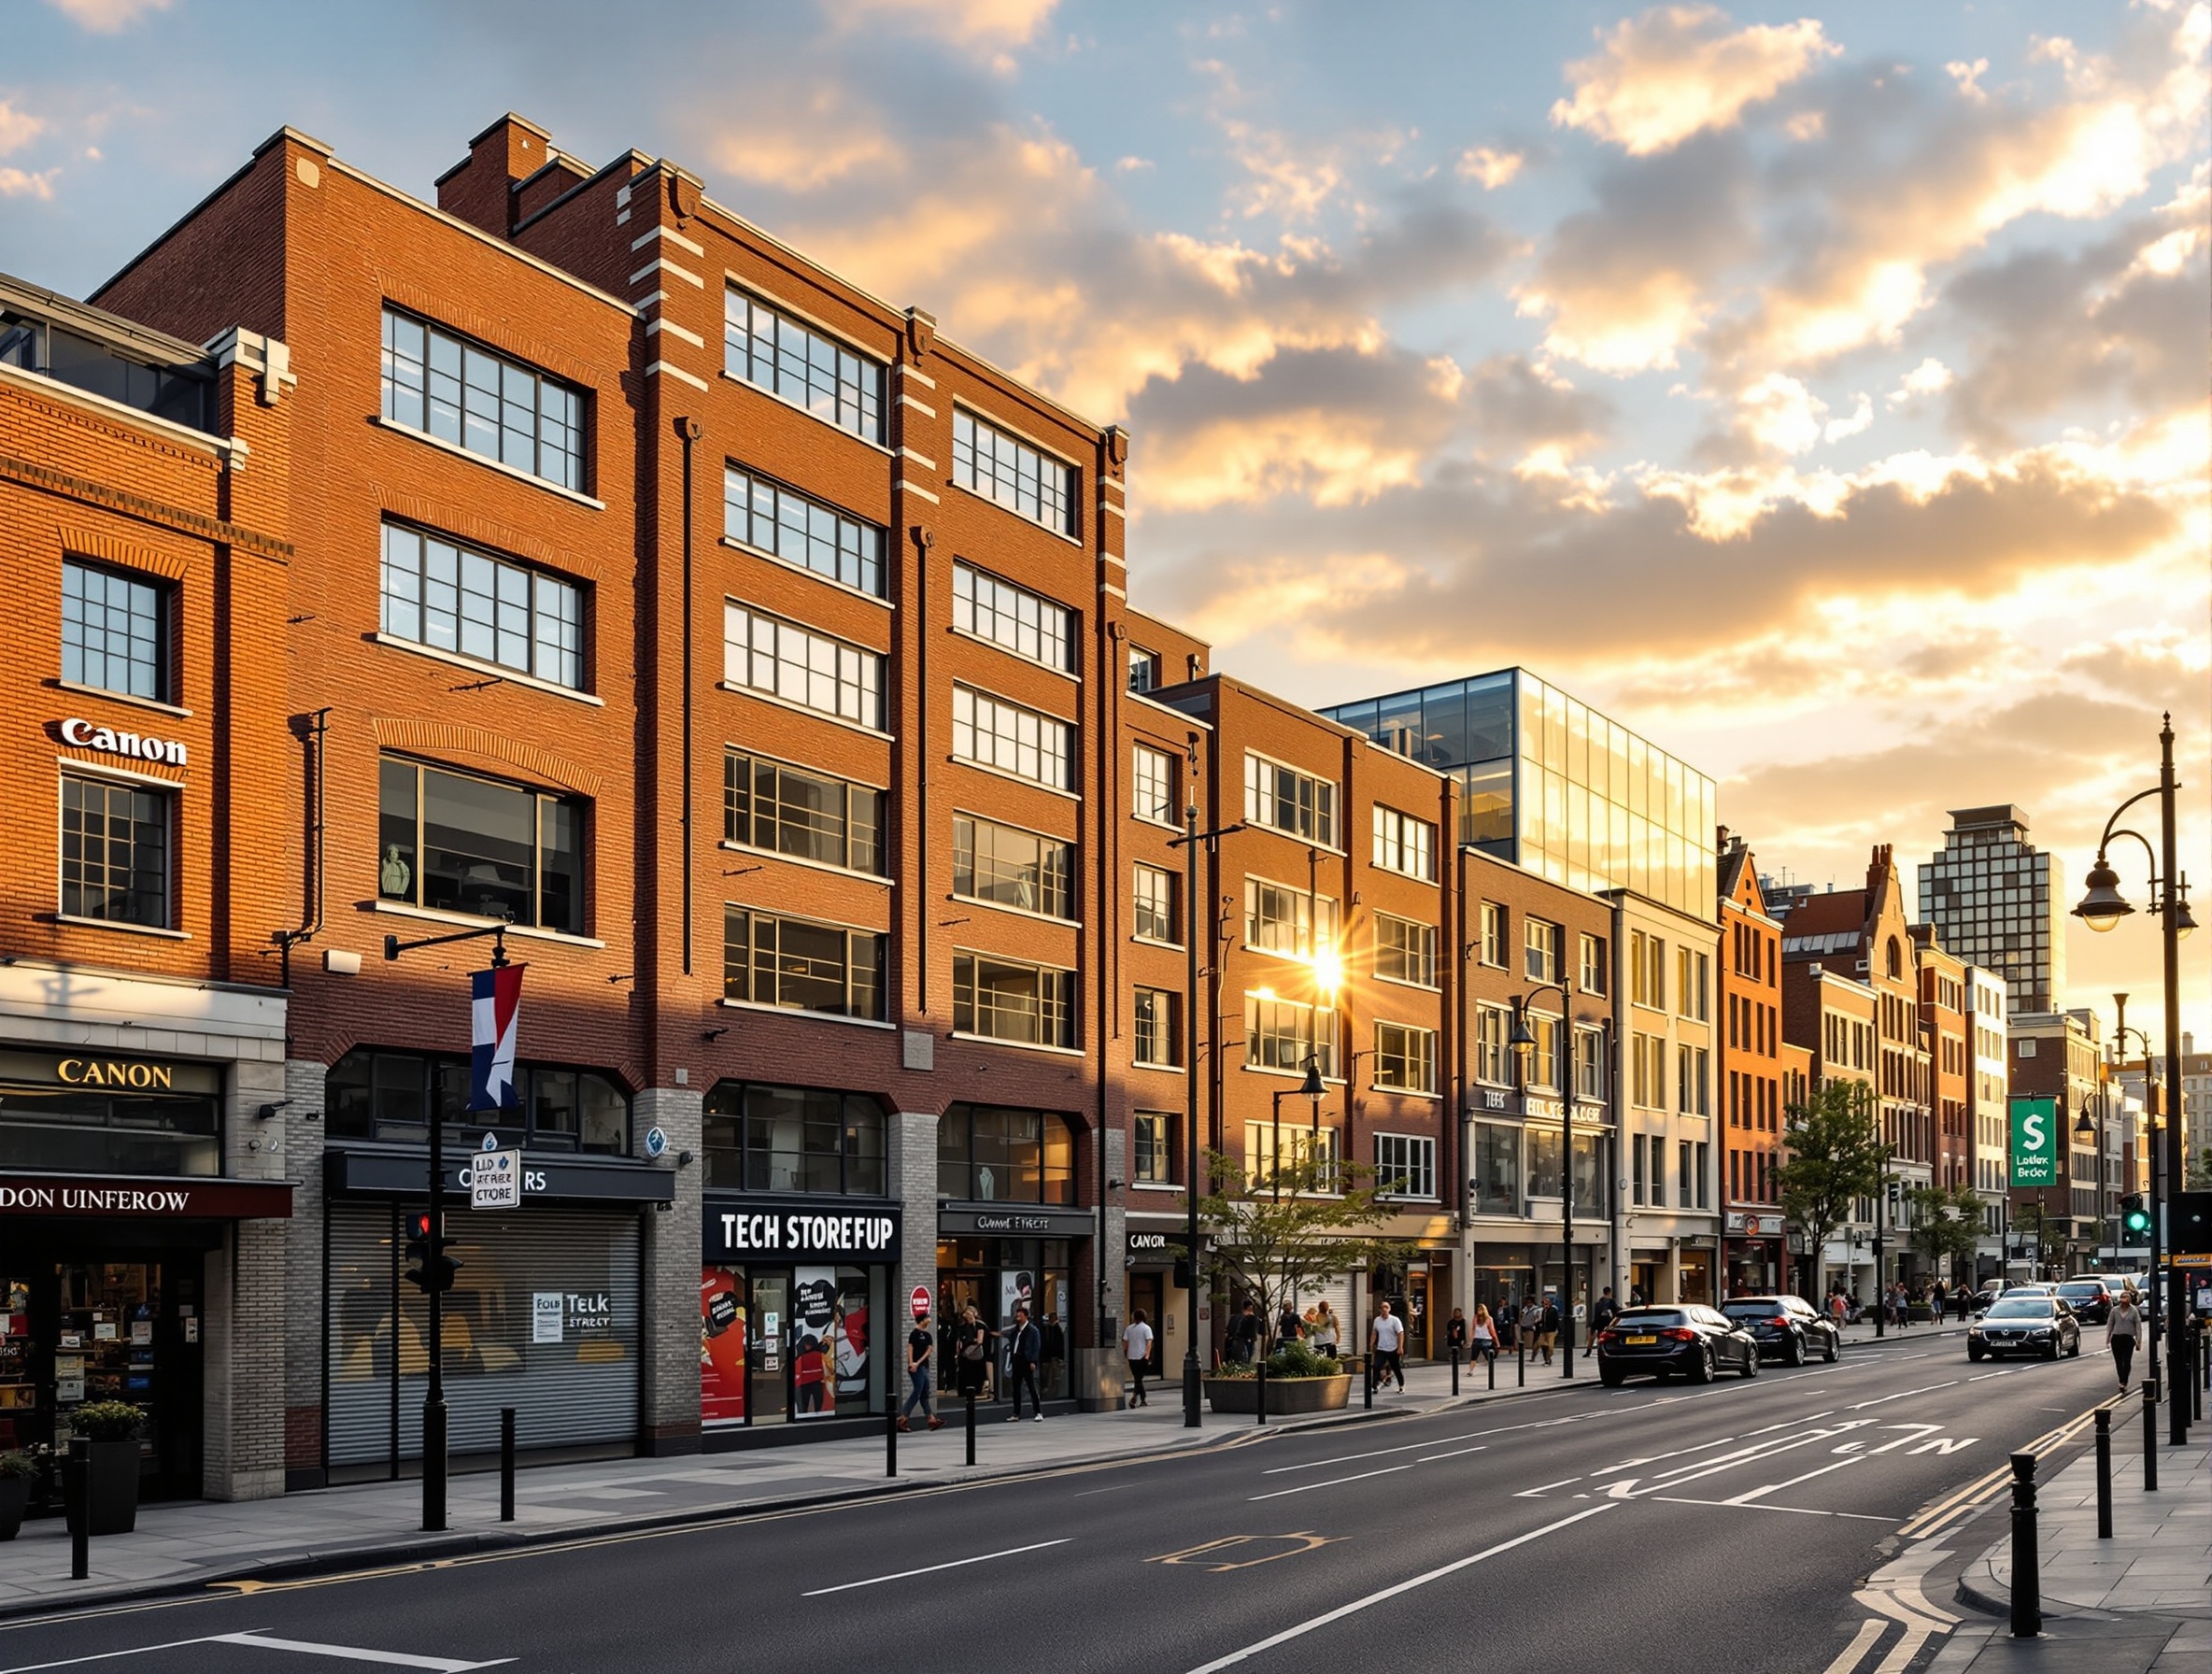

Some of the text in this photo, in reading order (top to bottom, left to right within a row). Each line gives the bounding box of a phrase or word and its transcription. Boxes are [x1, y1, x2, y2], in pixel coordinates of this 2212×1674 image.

[62, 717, 187, 766] Canon
[58, 1058, 173, 1090] CANON
[2022, 1114, 2046, 1151] S
[62, 1188, 190, 1212] UINFEROW
[720, 1213, 894, 1251] TECH STOREFUP
